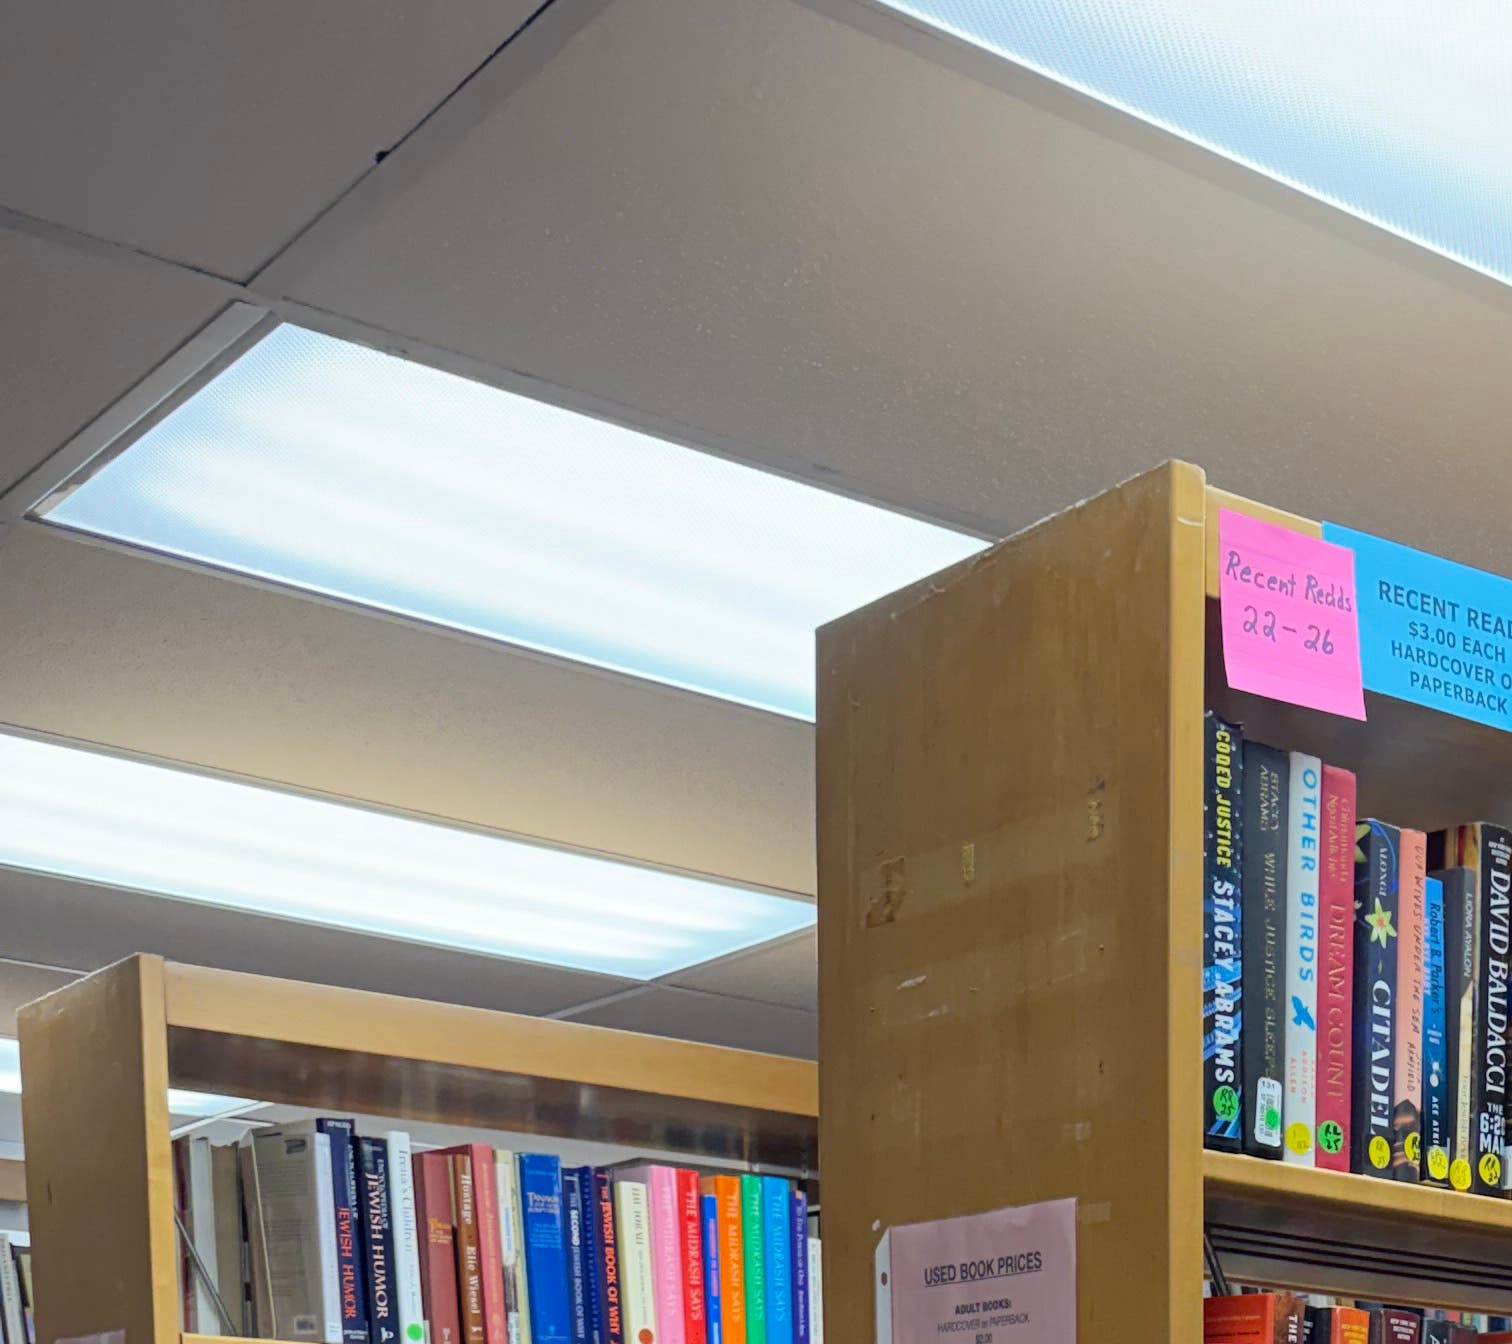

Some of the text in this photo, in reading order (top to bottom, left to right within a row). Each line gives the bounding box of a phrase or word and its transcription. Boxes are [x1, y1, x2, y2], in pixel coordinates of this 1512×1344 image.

[1379, 579, 1459, 624] RECENT
[1408, 620, 1506, 664] $3.00 EACH
[1391, 640, 1495, 686] HARDCOVER
[1409, 669, 1508, 715] PAPERBACK
[1213, 730, 1234, 1084] CODED JUSTICE STACEY ABRAMS
[1298, 768, 1317, 982] OTHER BIRDS
[1485, 868, 1511, 1092] DAVID BALDACCI
[1370, 980, 1392, 1135] CITADEL
[339, 1208, 356, 1319] JEWISH HUMOR
[365, 1174, 388, 1318] JEWISH HUMOR
[925, 1251, 1042, 1284] USED BOOK PRICES
